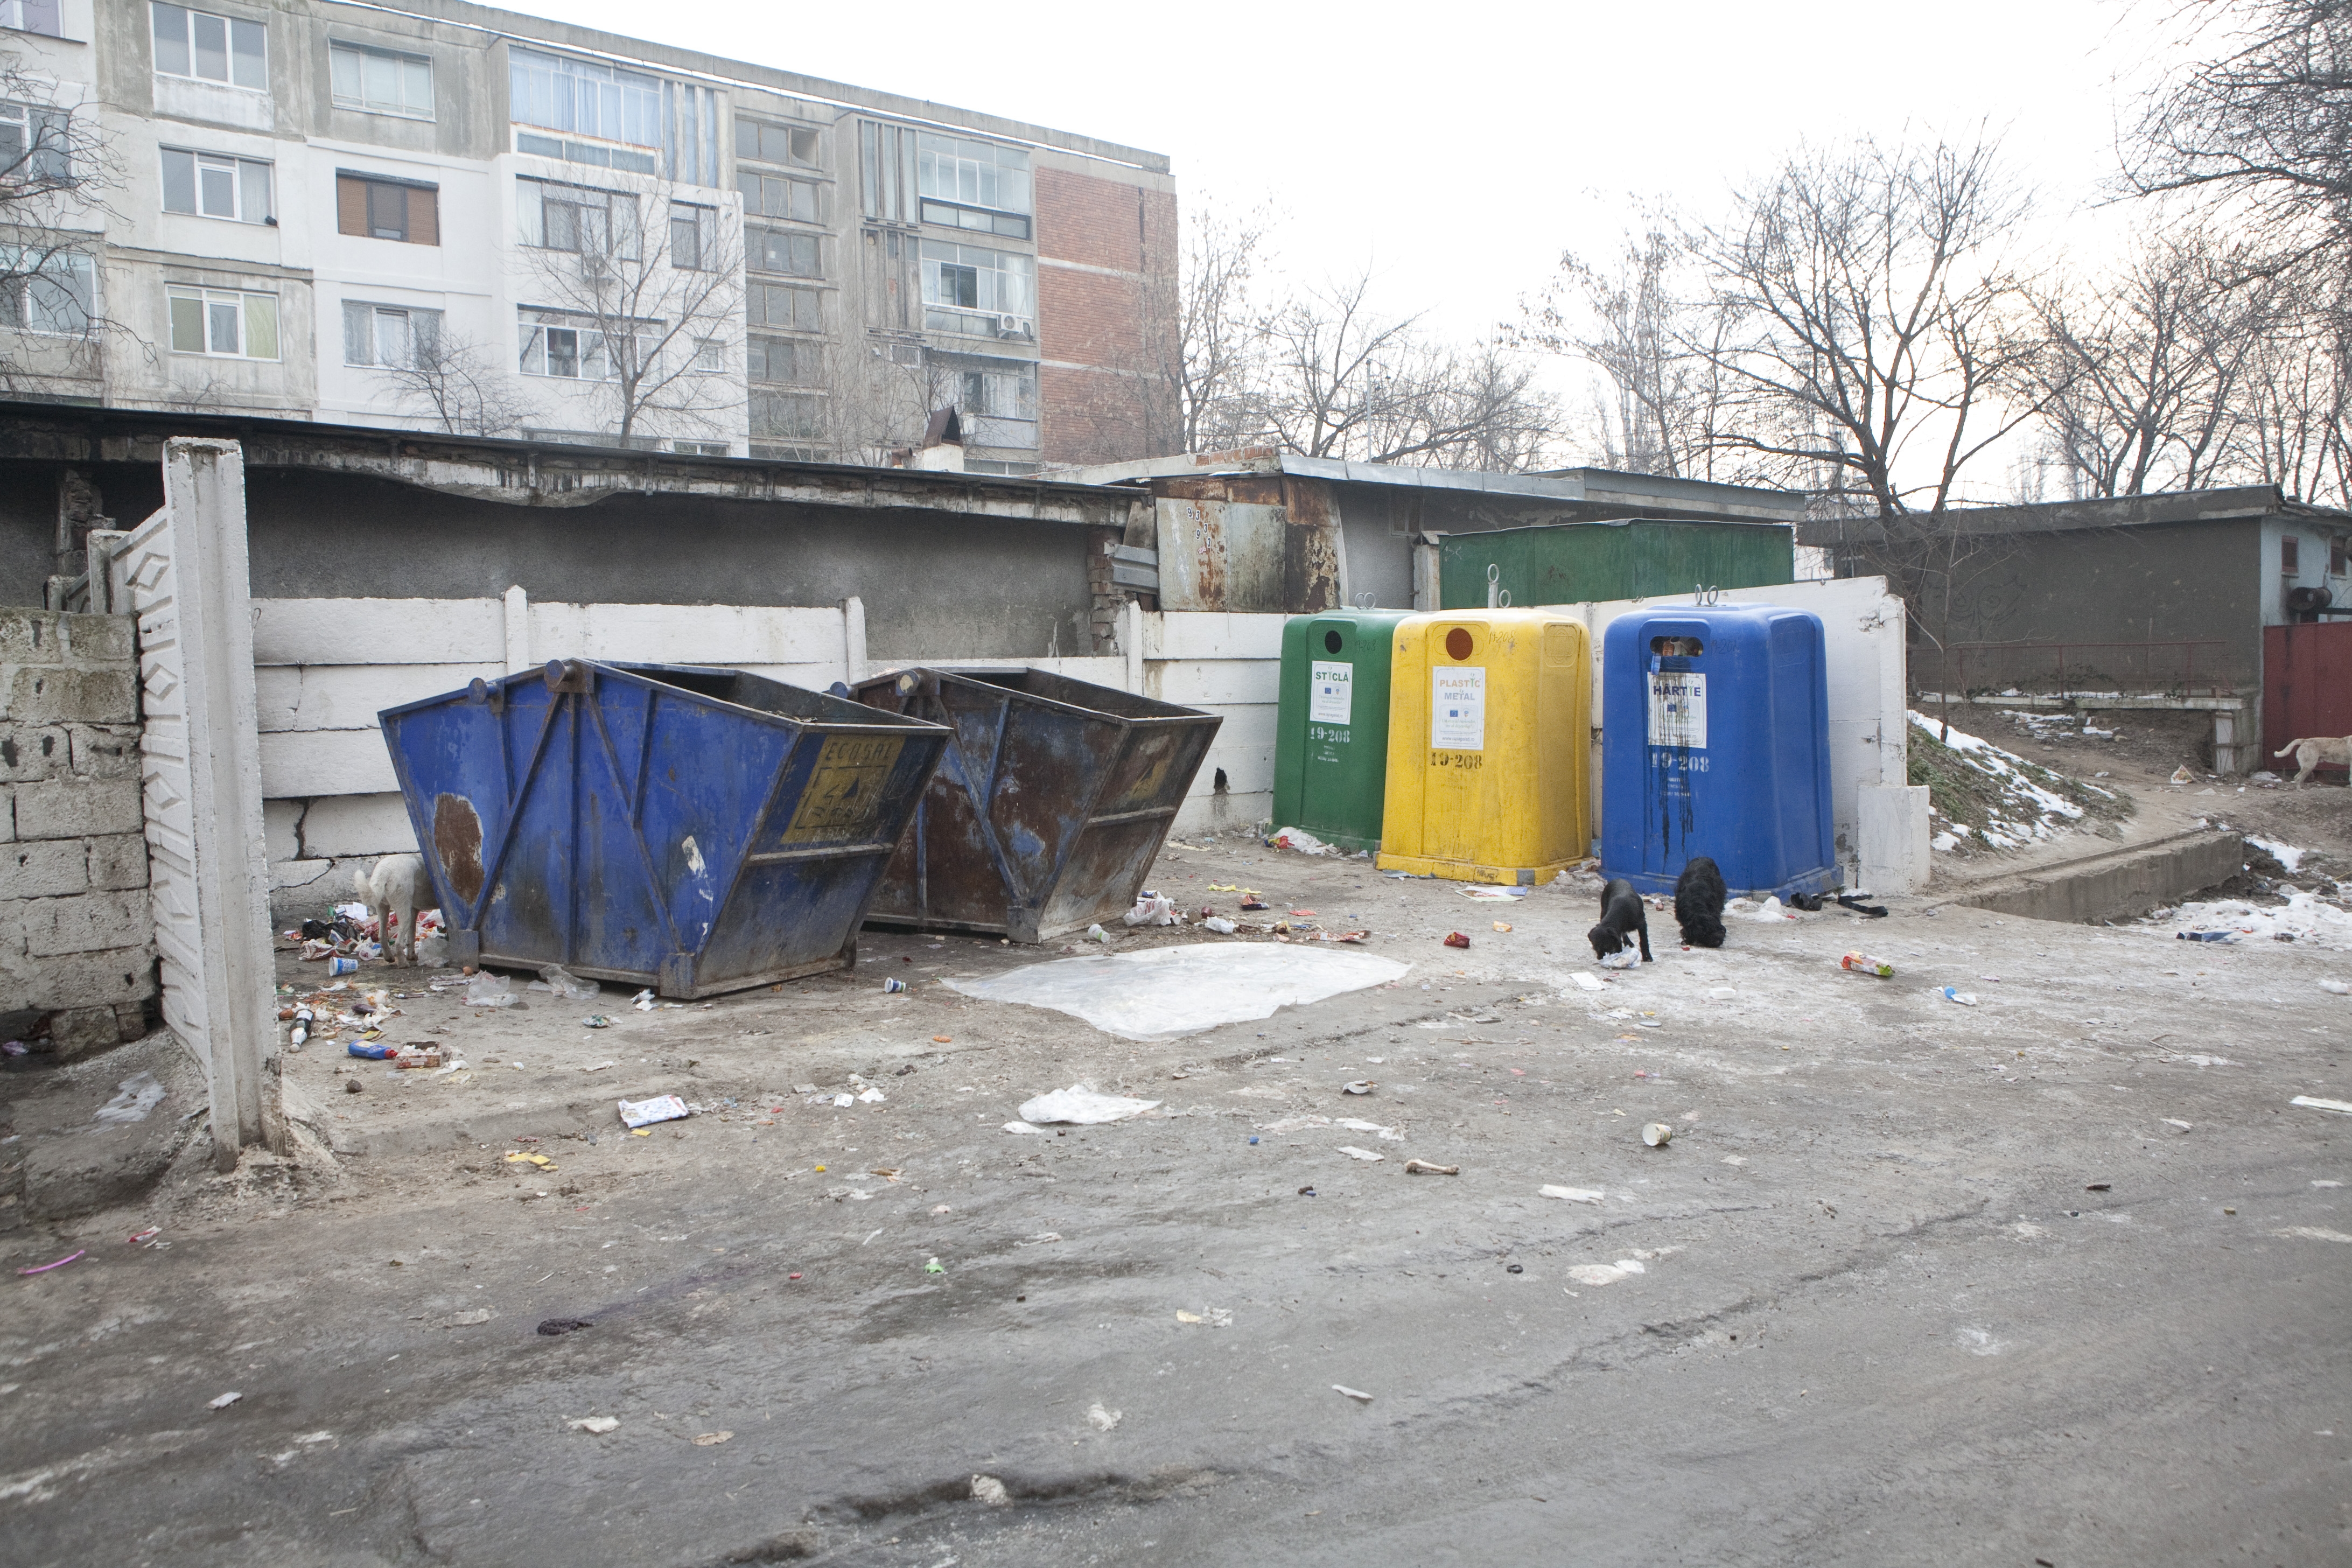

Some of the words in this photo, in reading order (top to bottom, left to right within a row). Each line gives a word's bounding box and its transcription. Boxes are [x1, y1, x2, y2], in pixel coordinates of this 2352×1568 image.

[1187, 508, 1192, 517] 9
[1196, 511, 1200, 520] 3
[1204, 524, 1207, 533] 3
[1196, 530, 1200, 540] 9
[1207, 538, 1211, 547] 3
[1439, 678, 1480, 688] PLASTIC
[1444, 692, 1475, 701] METAL
[1310, 726, 1350, 743] 19-208
[1431, 752, 1482, 769] 19-208
[1651, 752, 1709, 772] 19-208
